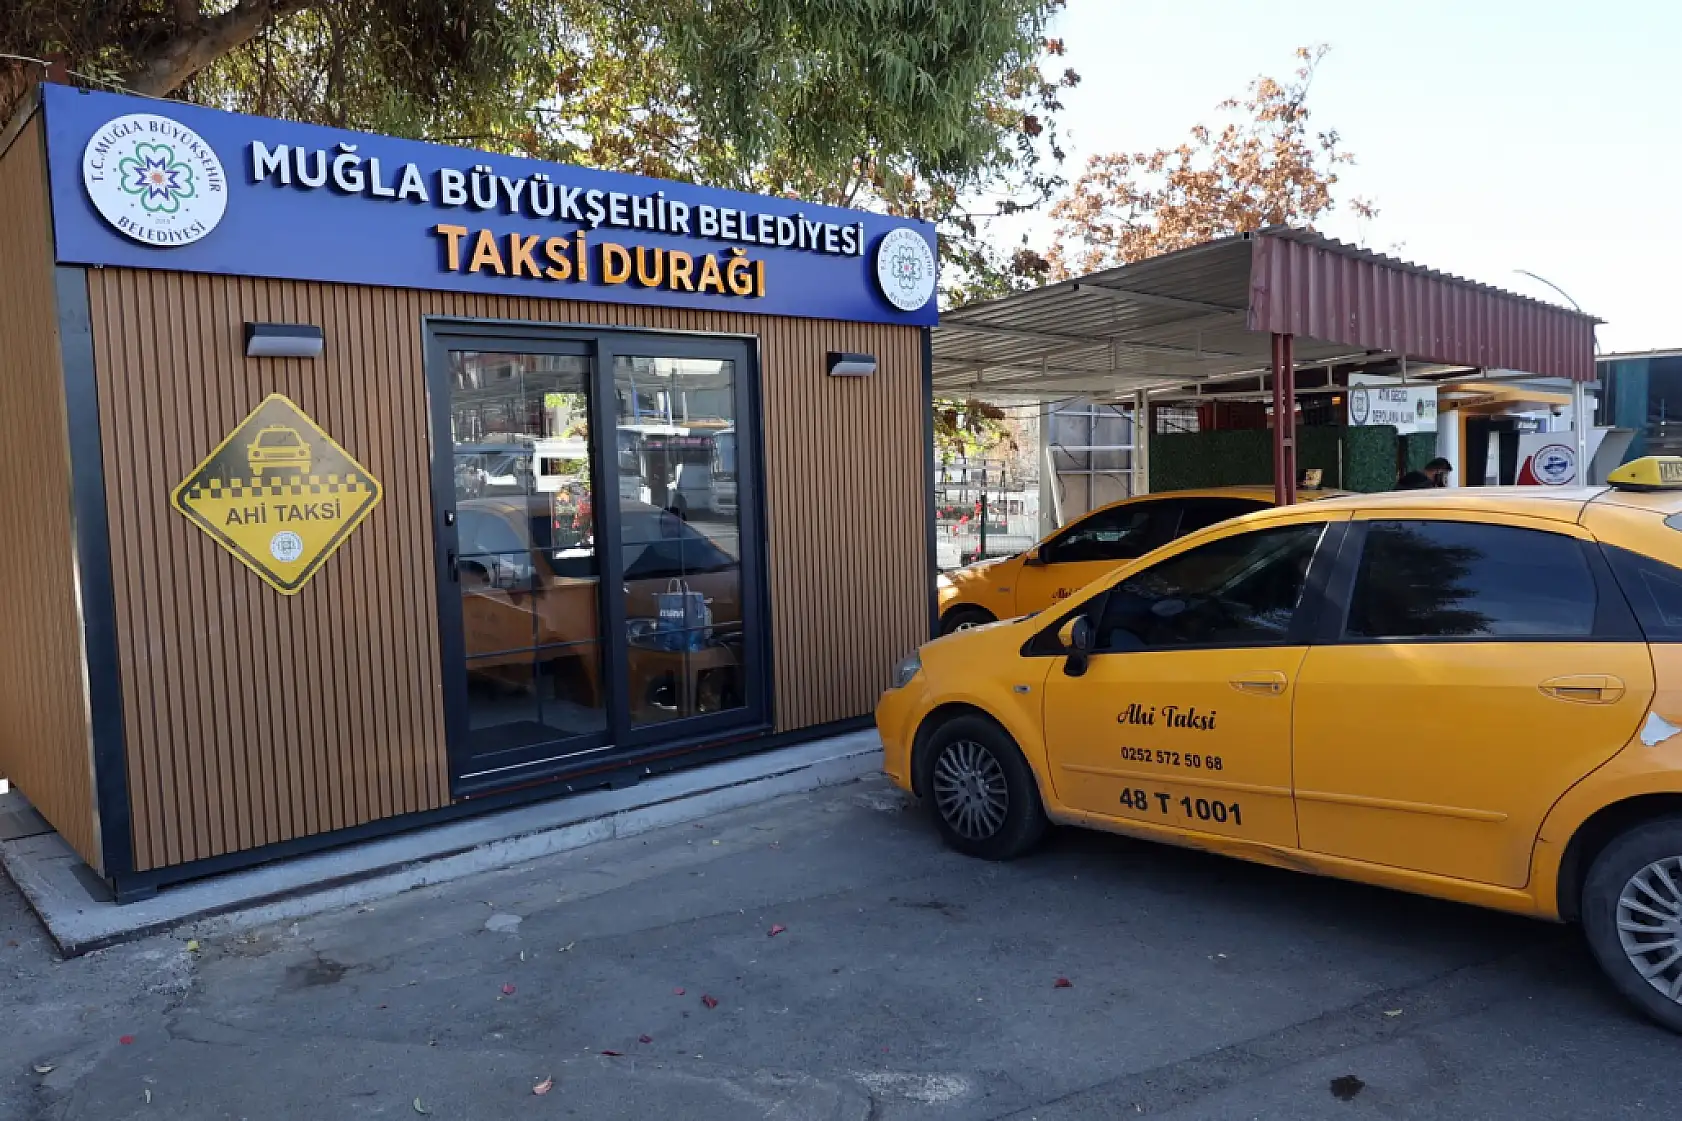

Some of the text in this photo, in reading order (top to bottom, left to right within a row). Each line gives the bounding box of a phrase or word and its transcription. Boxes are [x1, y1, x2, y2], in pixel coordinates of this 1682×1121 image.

[250, 140, 430, 202] MUĞLA
[440, 164, 691, 233] BÜYÜKŞEHİR
[699, 204, 865, 257] BELEDİYESİ
[118, 215, 207, 243] BELEDİYESİ
[437, 223, 766, 298] TAKSİ DURAĞI
[225, 498, 341, 525] AHİ TAKSİ
[1117, 703, 1217, 731] Ahi Taksi
[1120, 746, 1223, 771] 0252 572 50 68
[1120, 787, 1242, 826] 48 T 1001
